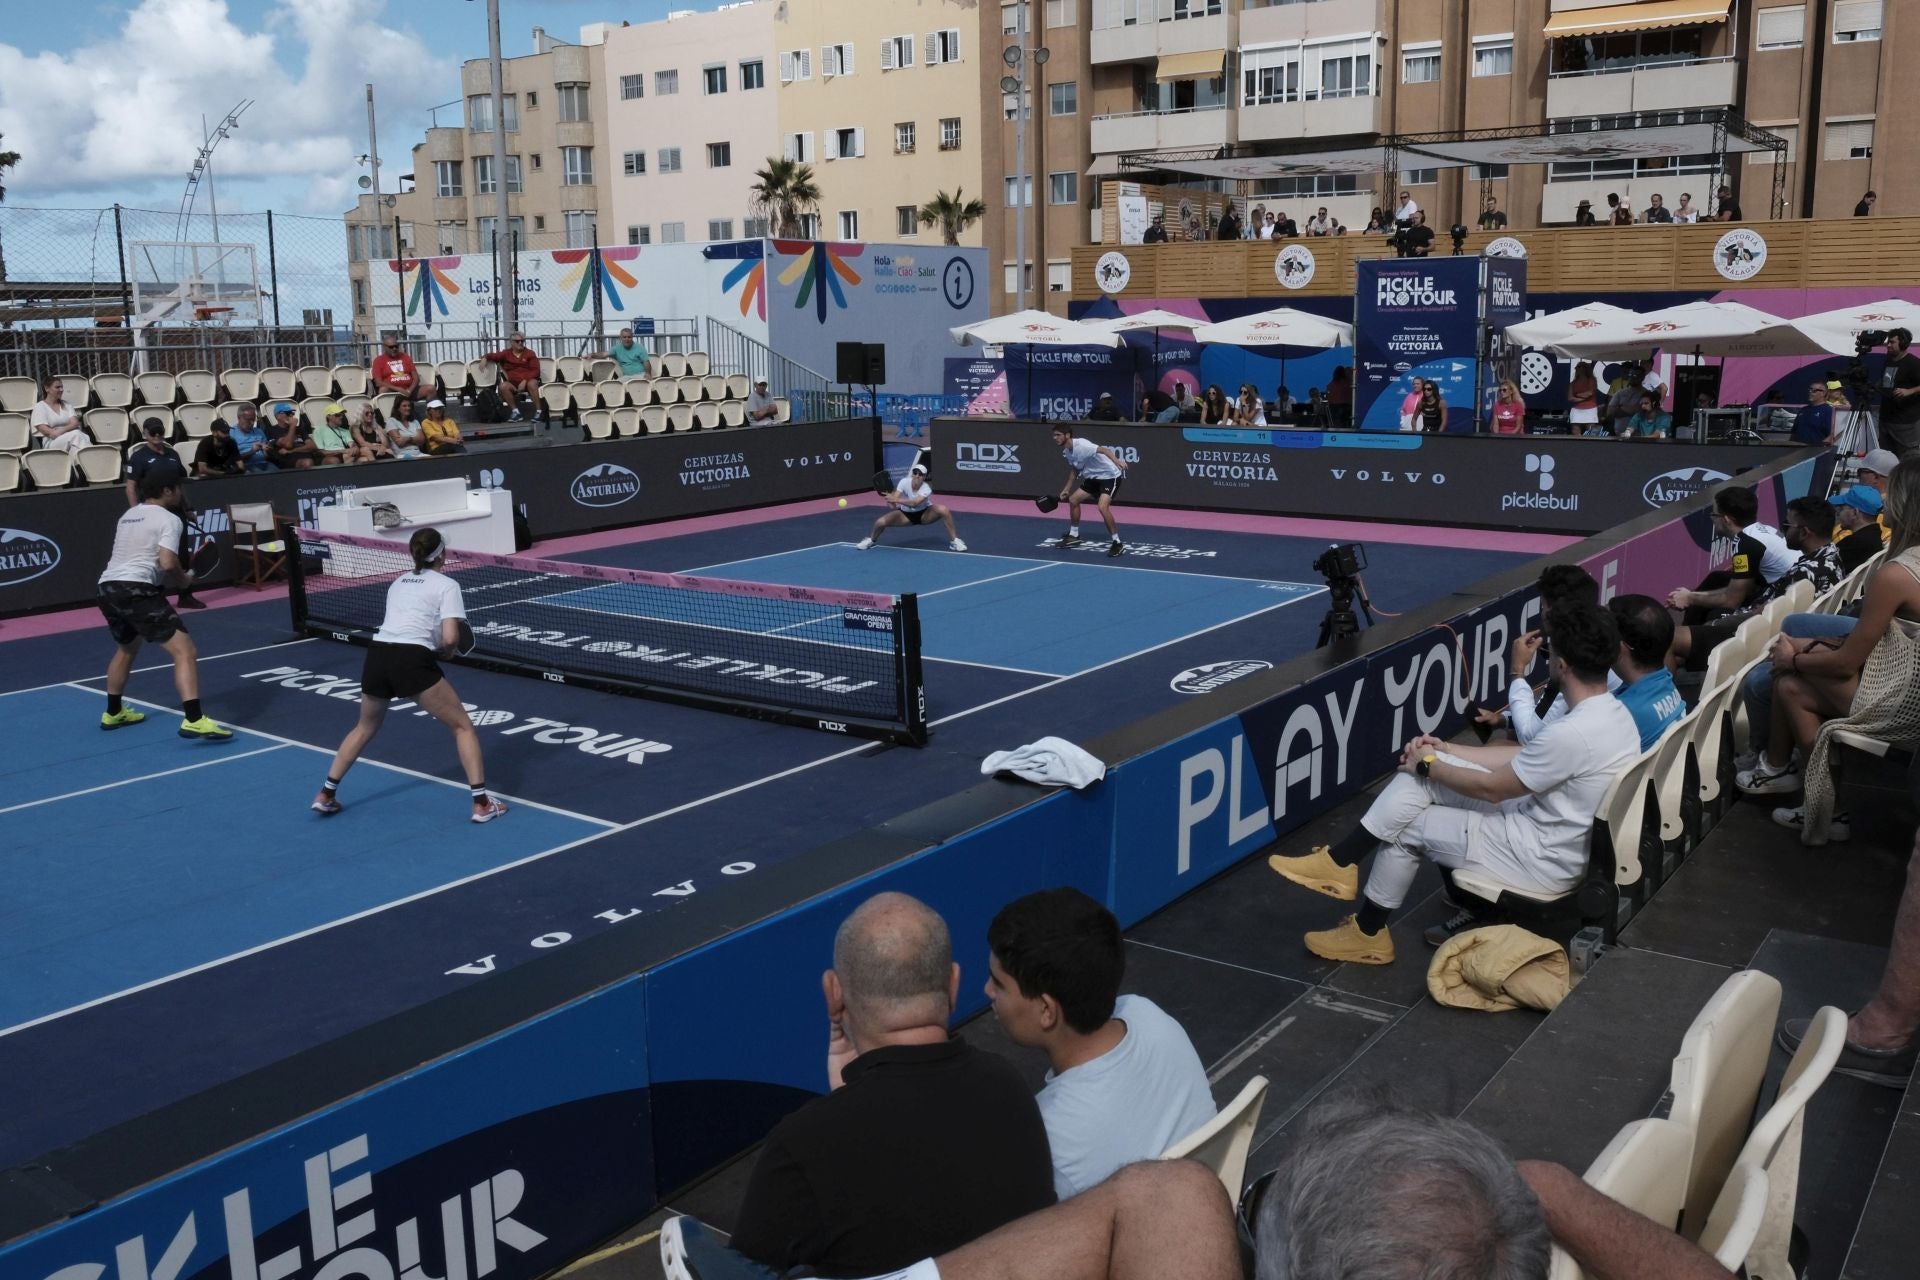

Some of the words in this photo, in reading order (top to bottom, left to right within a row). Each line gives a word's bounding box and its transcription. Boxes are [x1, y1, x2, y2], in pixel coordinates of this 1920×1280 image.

[874, 256, 891, 265] Hola
[918, 267, 936, 277] Salut
[469, 277, 490, 294] Las
[1377, 276, 1434, 292] PICKLE
[1492, 277, 1513, 292] PICKLE
[476, 297, 486, 306] de
[1377, 291, 1410, 306] PRO
[1410, 290, 1458, 306] TOUR
[1387, 342, 1443, 351] VICTORIA
[1040, 398, 1093, 413] PICKLE
[684, 452, 745, 469] CERVEZAS
[784, 452, 852, 468] VOLVO
[1193, 450, 1271, 464] CERVEZAS
[958, 462, 1018, 471] PICKLEBALL
[1185, 463, 1279, 481] VICTORIA
[679, 465, 750, 486] VICTORIA
[1330, 469, 1446, 484] VOLVO
[296, 488, 329, 496] Cervezas
[577, 481, 636, 499] ASTURIANA
[1502, 491, 1578, 511] picklebull
[1384, 612, 1508, 753] YOUR
[500, 717, 673, 765] TOUR
[1177, 679, 1365, 875] PLAY
[444, 861, 757, 976] VOLVO
